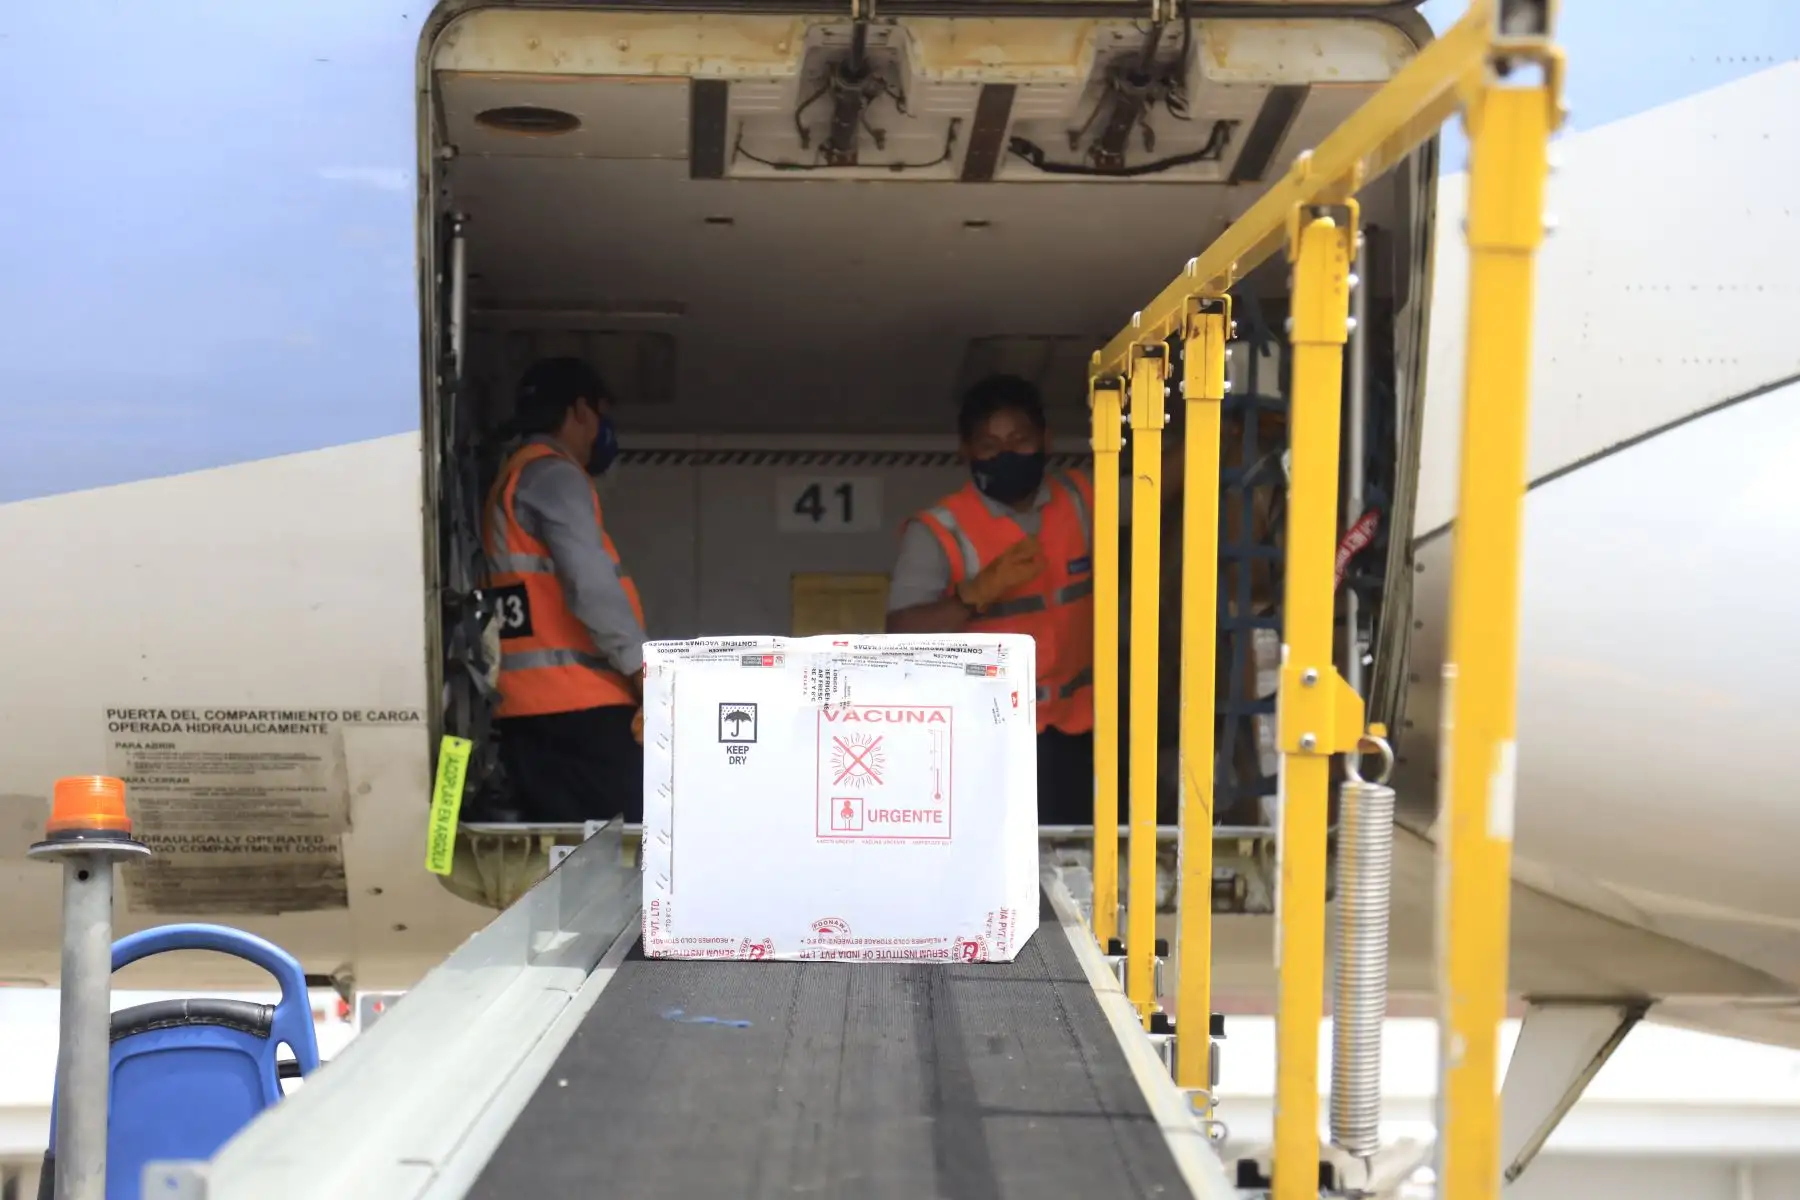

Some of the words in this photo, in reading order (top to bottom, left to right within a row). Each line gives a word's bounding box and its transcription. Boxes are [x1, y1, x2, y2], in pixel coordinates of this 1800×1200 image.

[793, 482, 853, 523] 41
[107, 709, 168, 721] PUERTA
[171, 710, 200, 721] DEL
[205, 710, 338, 722] COMPARTIMIENTO
[343, 711, 362, 722] DE
[367, 711, 420, 722] CARGA
[823, 710, 946, 723] VACUNA
[108, 722, 182, 733] OPERADA
[186, 722, 329, 734] HIDRAULICAMENTE
[115, 742, 143, 750] PARA
[145, 742, 176, 750] ABRIR
[726, 745, 749, 755] KEEP
[729, 756, 747, 765] DRY
[867, 809, 943, 823] URGENTE
[133, 834, 241, 844] DRAULICALLY
[246, 834, 324, 844] OPERATED
[180, 845, 291, 854] COMPARTMENT
[295, 845, 338, 854] DOOR
[650, 898, 660, 917] LTD.
[818, 950, 836, 959] PVT.
[838, 950, 861, 959] INDIA
[862, 950, 873, 958] OF
[876, 950, 918, 959] INSTITUTE
[920, 949, 949, 958] SERUM
